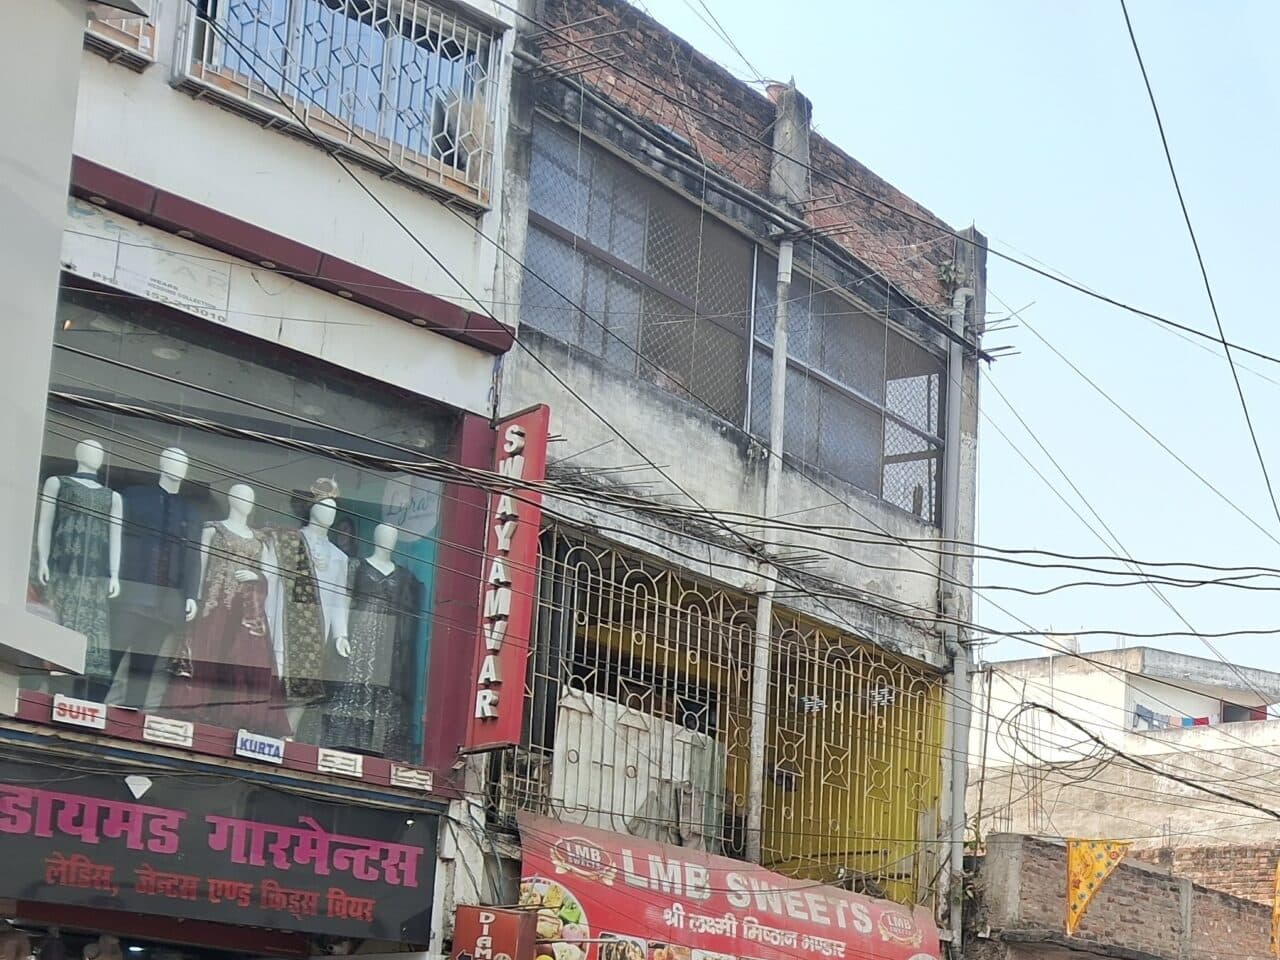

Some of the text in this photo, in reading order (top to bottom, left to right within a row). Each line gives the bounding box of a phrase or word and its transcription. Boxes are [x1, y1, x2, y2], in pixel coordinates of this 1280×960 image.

[55, 699, 102, 723] SUIT
[238, 735, 283, 761] KURTA
[564, 841, 602, 863] LMB
[621, 847, 873, 935] LMB SWEETS
[663, 902, 686, 930] श्री
